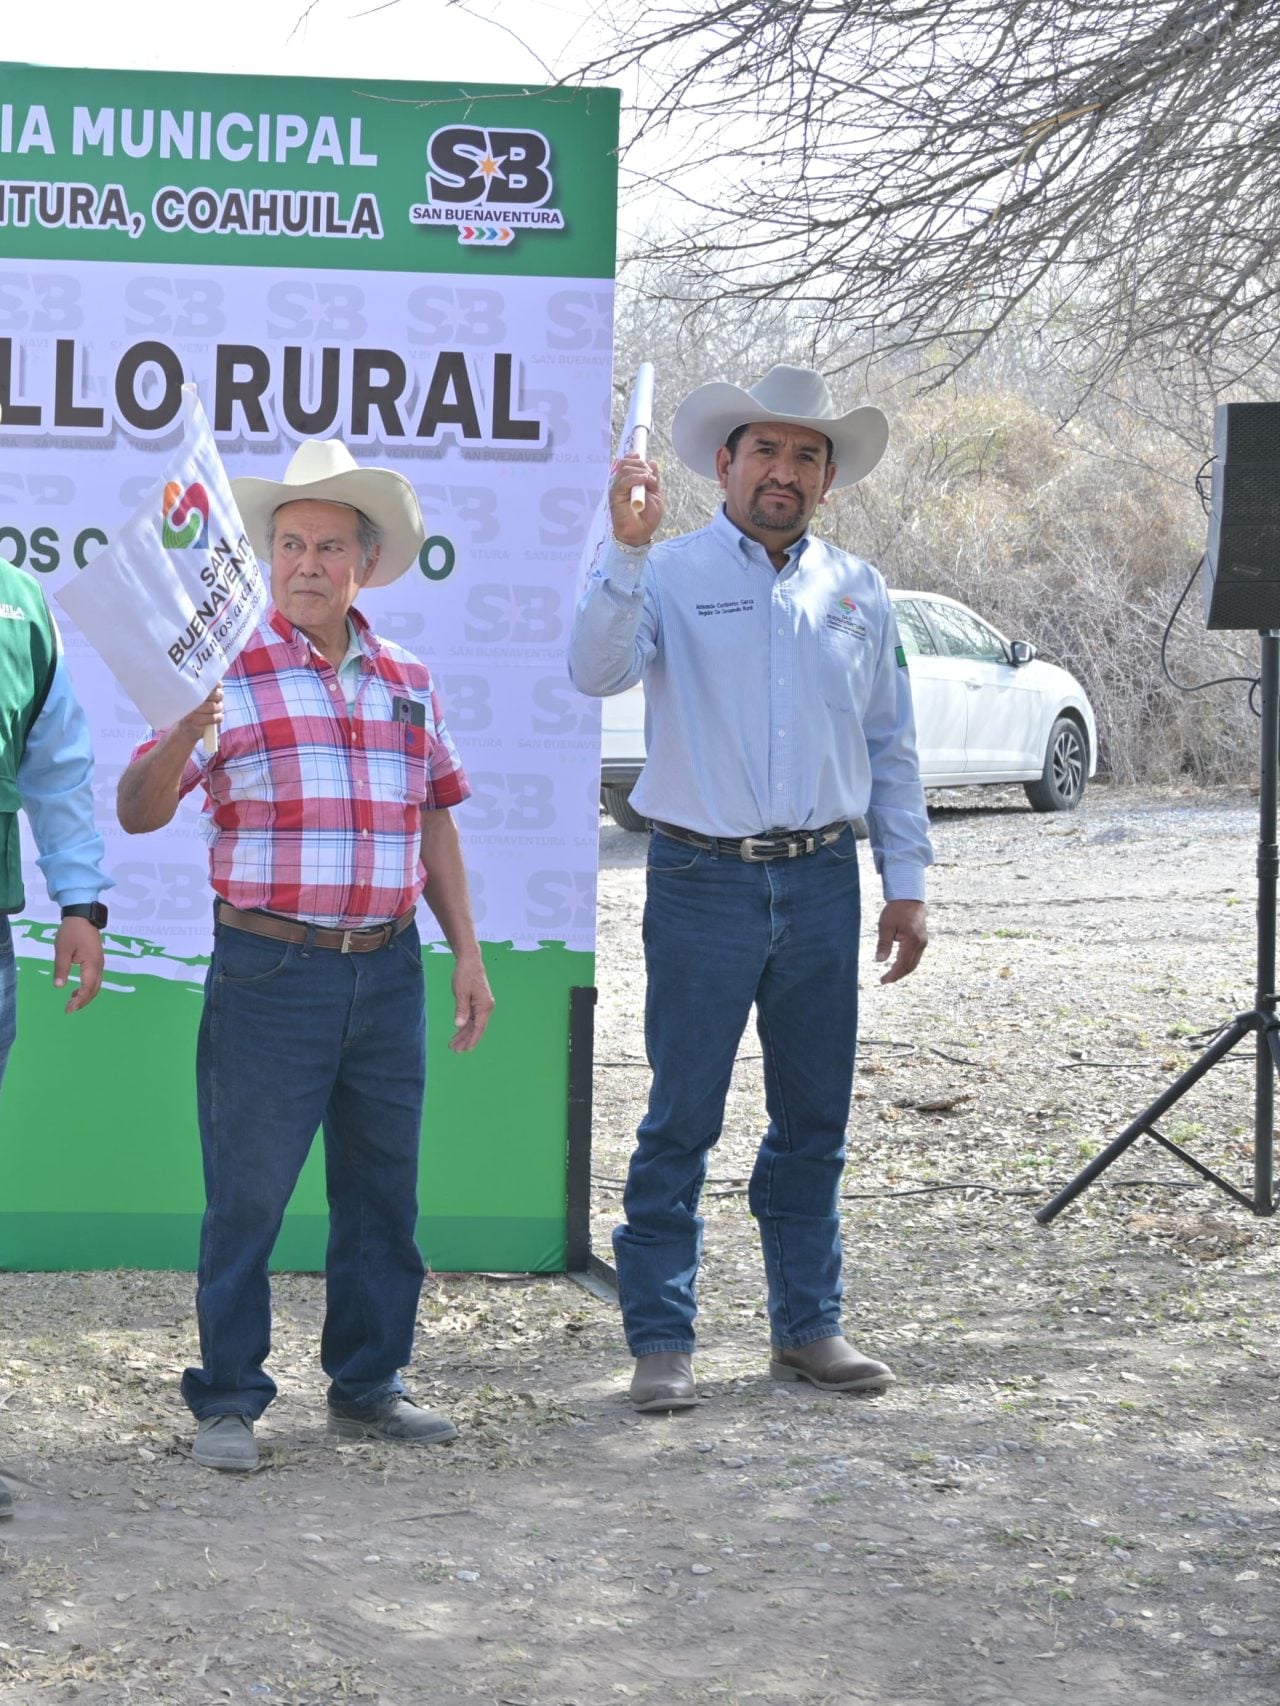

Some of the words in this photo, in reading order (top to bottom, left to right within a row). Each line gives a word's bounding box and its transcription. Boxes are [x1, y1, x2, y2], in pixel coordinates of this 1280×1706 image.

[72, 106, 378, 166] MUNICIPAL
[428, 127, 552, 205] SB
[157, 191, 380, 235] COAHUILA
[413, 207, 443, 220] SAN
[445, 209, 561, 225] BUENAVENTURA
[214, 344, 541, 440] RURAL
[200, 537, 232, 588] SAN
